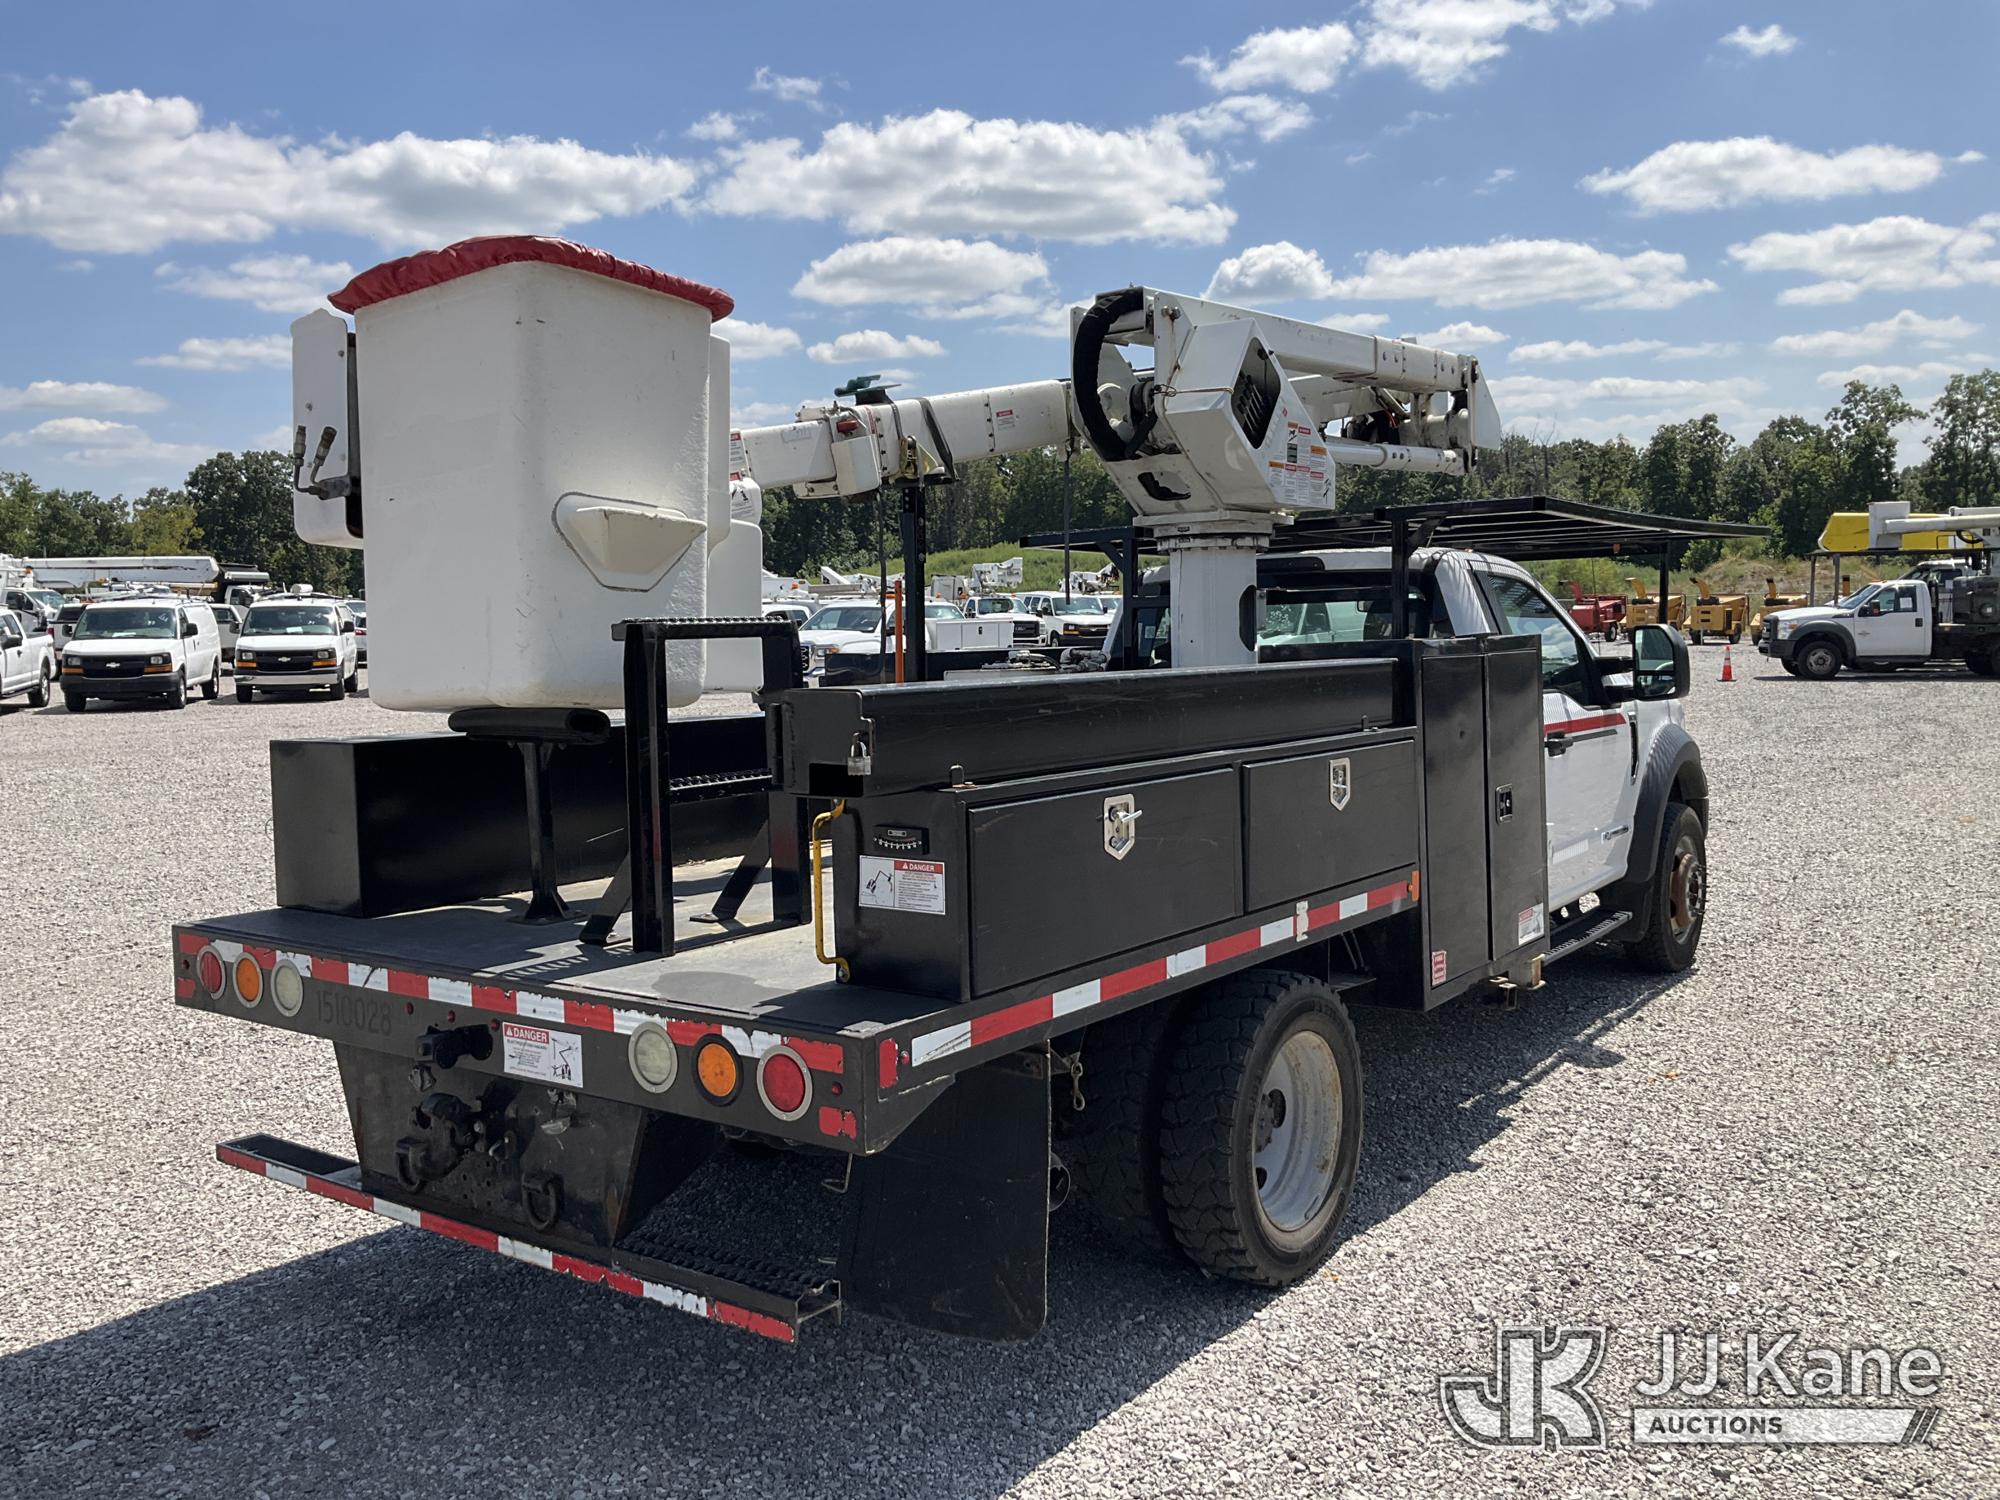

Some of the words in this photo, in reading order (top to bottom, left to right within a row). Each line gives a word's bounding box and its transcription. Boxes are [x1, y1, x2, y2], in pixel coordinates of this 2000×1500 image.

[909, 863, 935, 872] DANGER
[316, 990, 392, 1036] 1510028
[513, 1027, 547, 1043] DANGER
